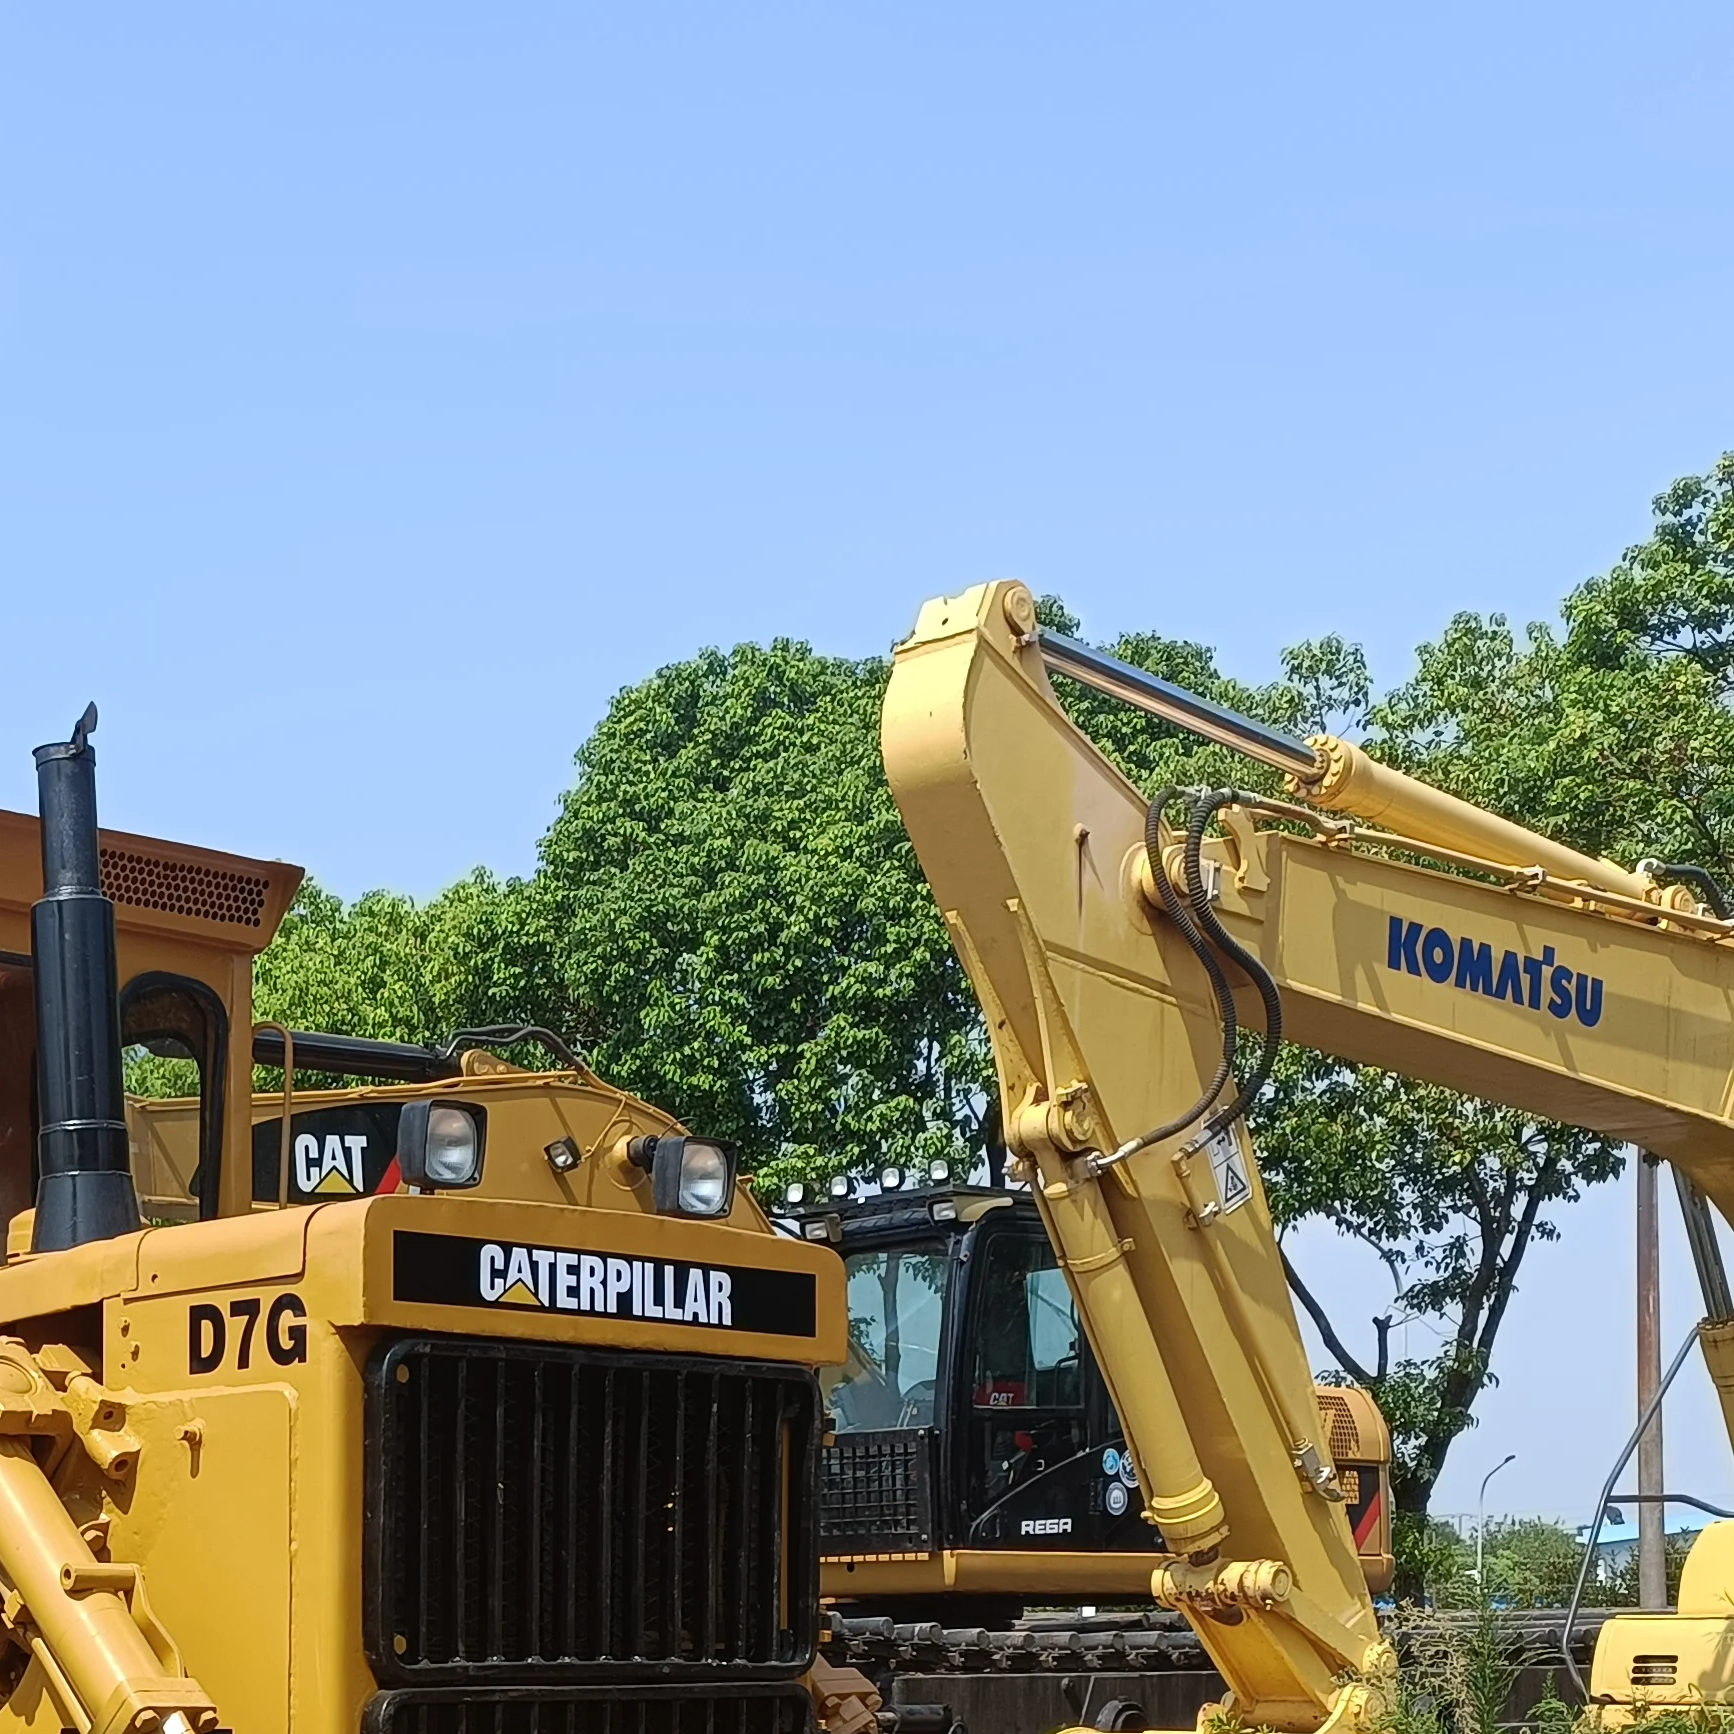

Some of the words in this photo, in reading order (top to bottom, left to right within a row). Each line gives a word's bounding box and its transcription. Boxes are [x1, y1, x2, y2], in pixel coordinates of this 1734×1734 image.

[1387, 916, 1604, 1028] KOMATSU
[294, 1133, 367, 1194] CAT
[479, 1243, 733, 1327] CATERPILLAR
[188, 1295, 308, 1375] D7G
[989, 1392, 1014, 1406] CAT
